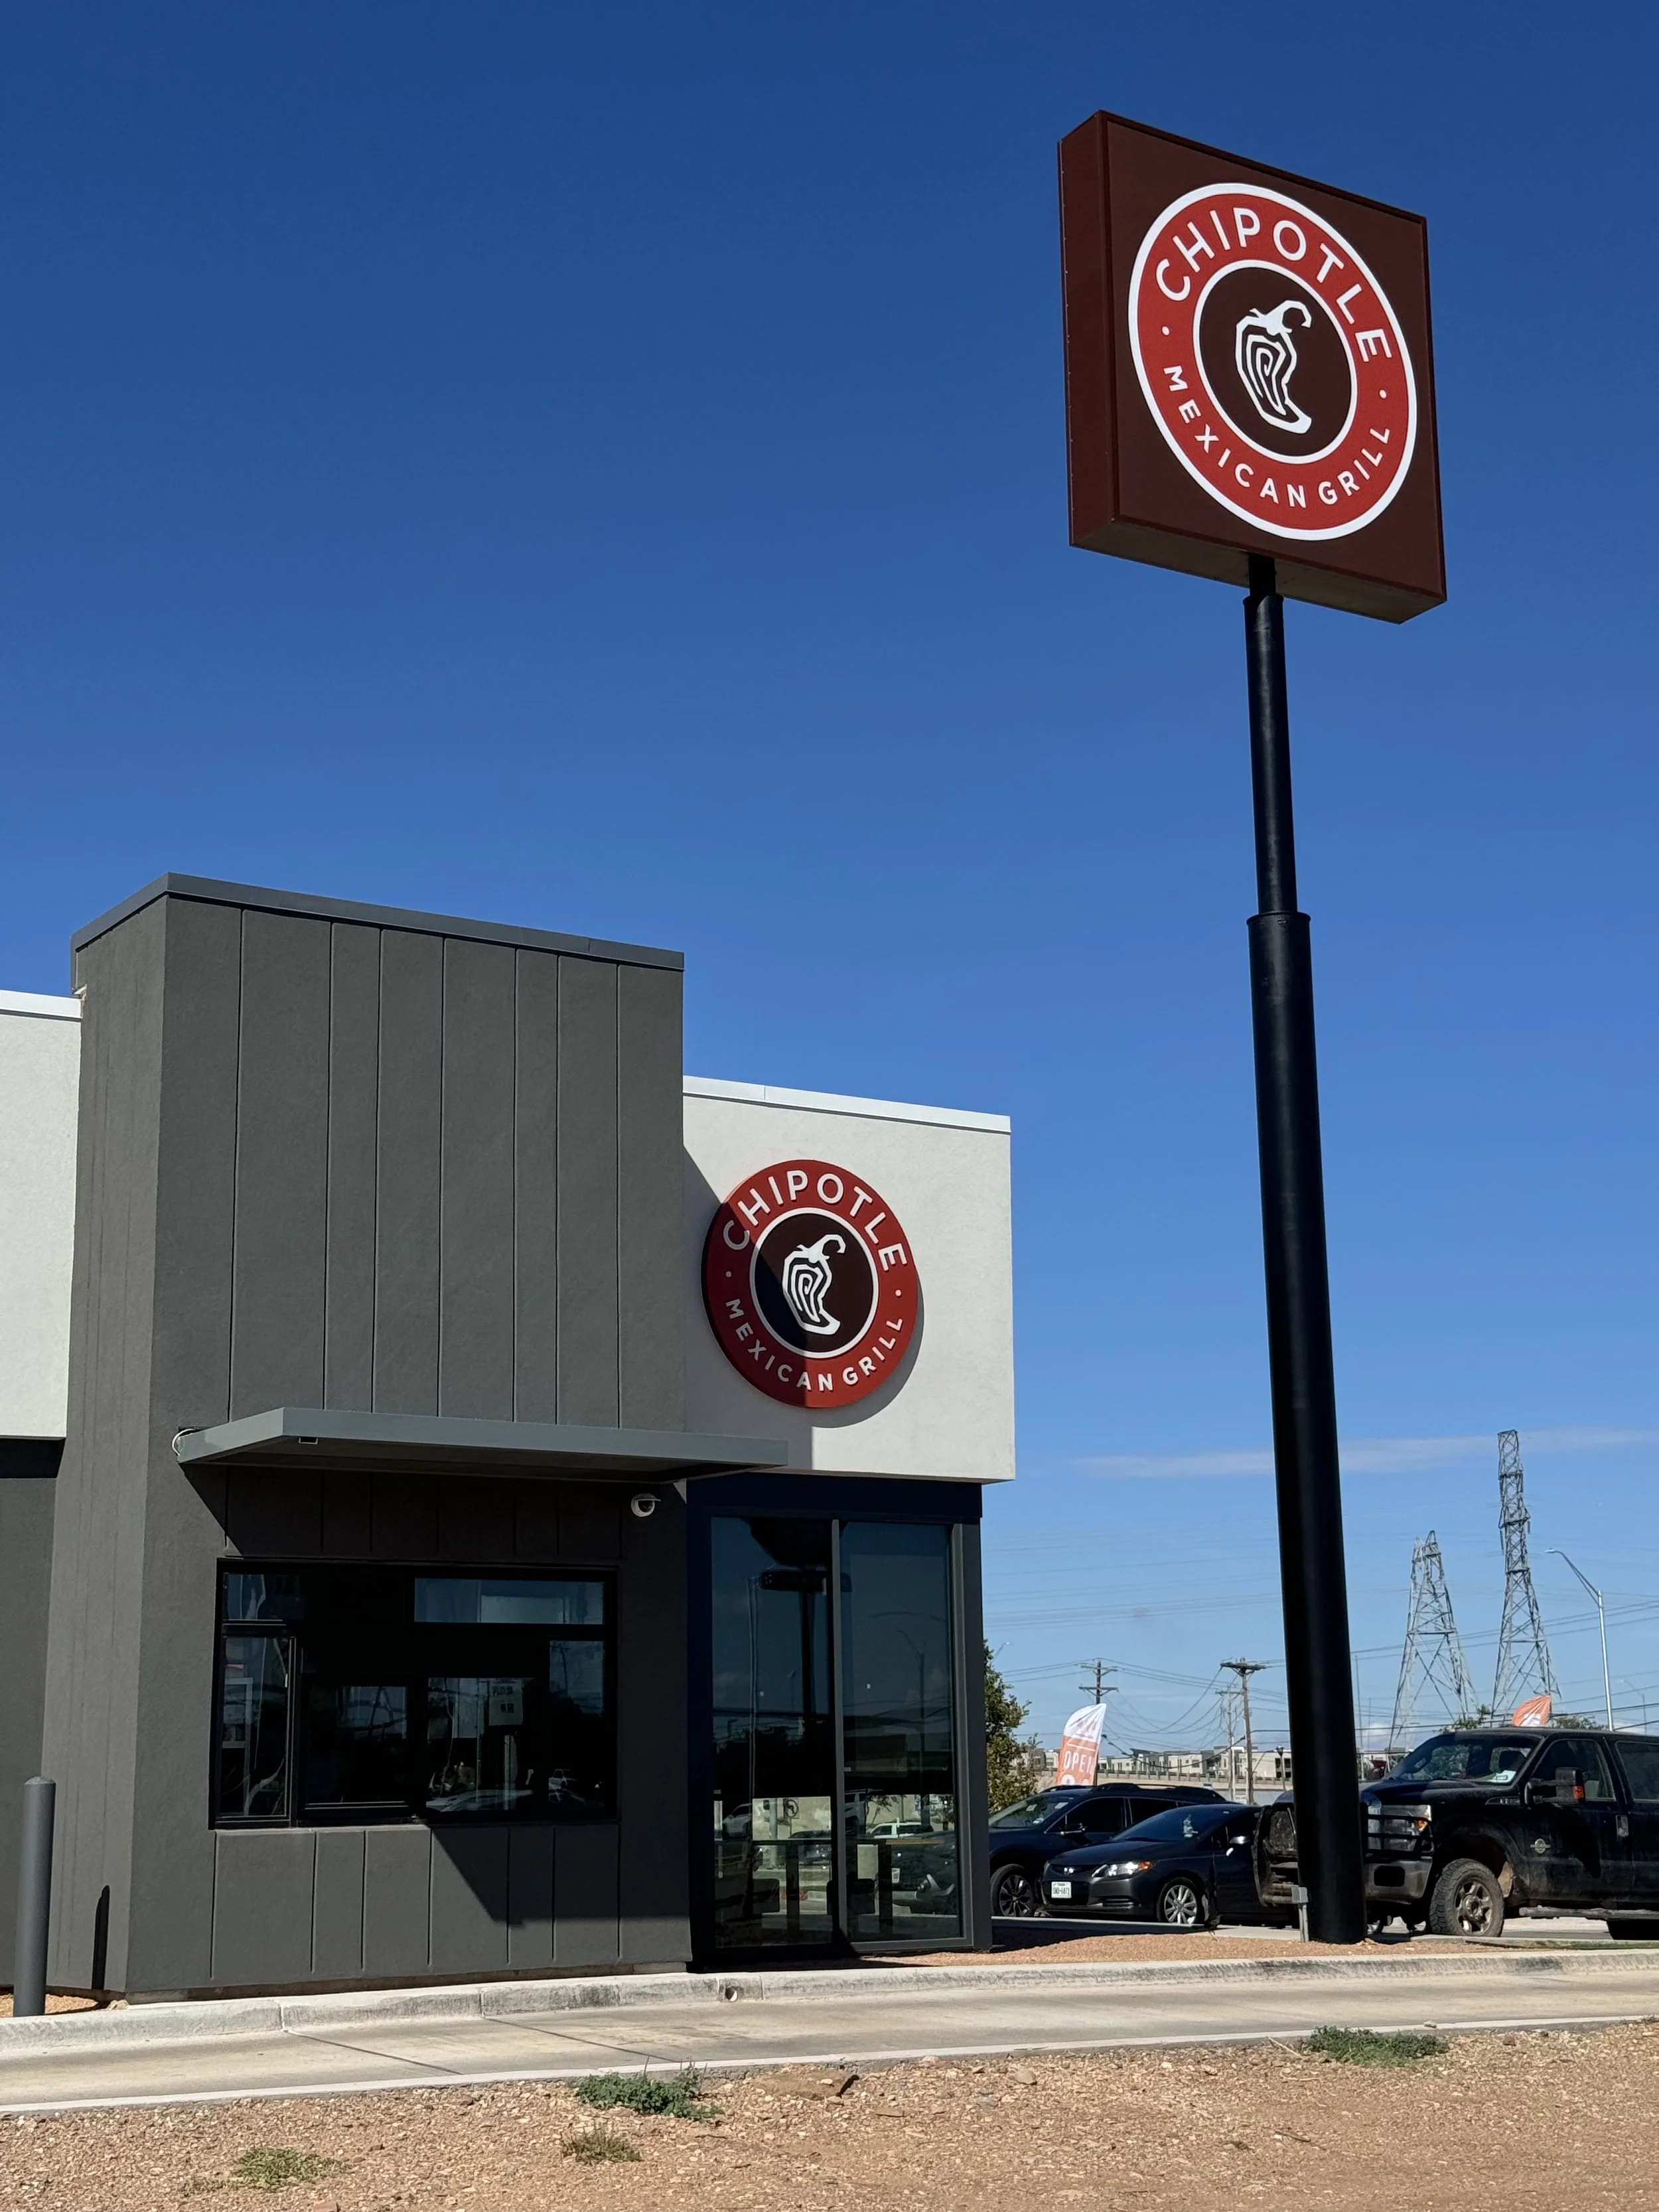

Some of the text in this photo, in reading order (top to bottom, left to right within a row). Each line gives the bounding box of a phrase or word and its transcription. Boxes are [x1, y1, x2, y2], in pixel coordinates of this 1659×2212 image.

[1156, 207, 1392, 362] CHIPOTLE
[1163, 365, 1390, 508] MEXICAN GRILL
[723, 1169, 908, 1271] CHIPOTLE
[725, 1298, 903, 1391] MEXICAN GRILL
[1064, 1750, 1095, 1775] OPEN
